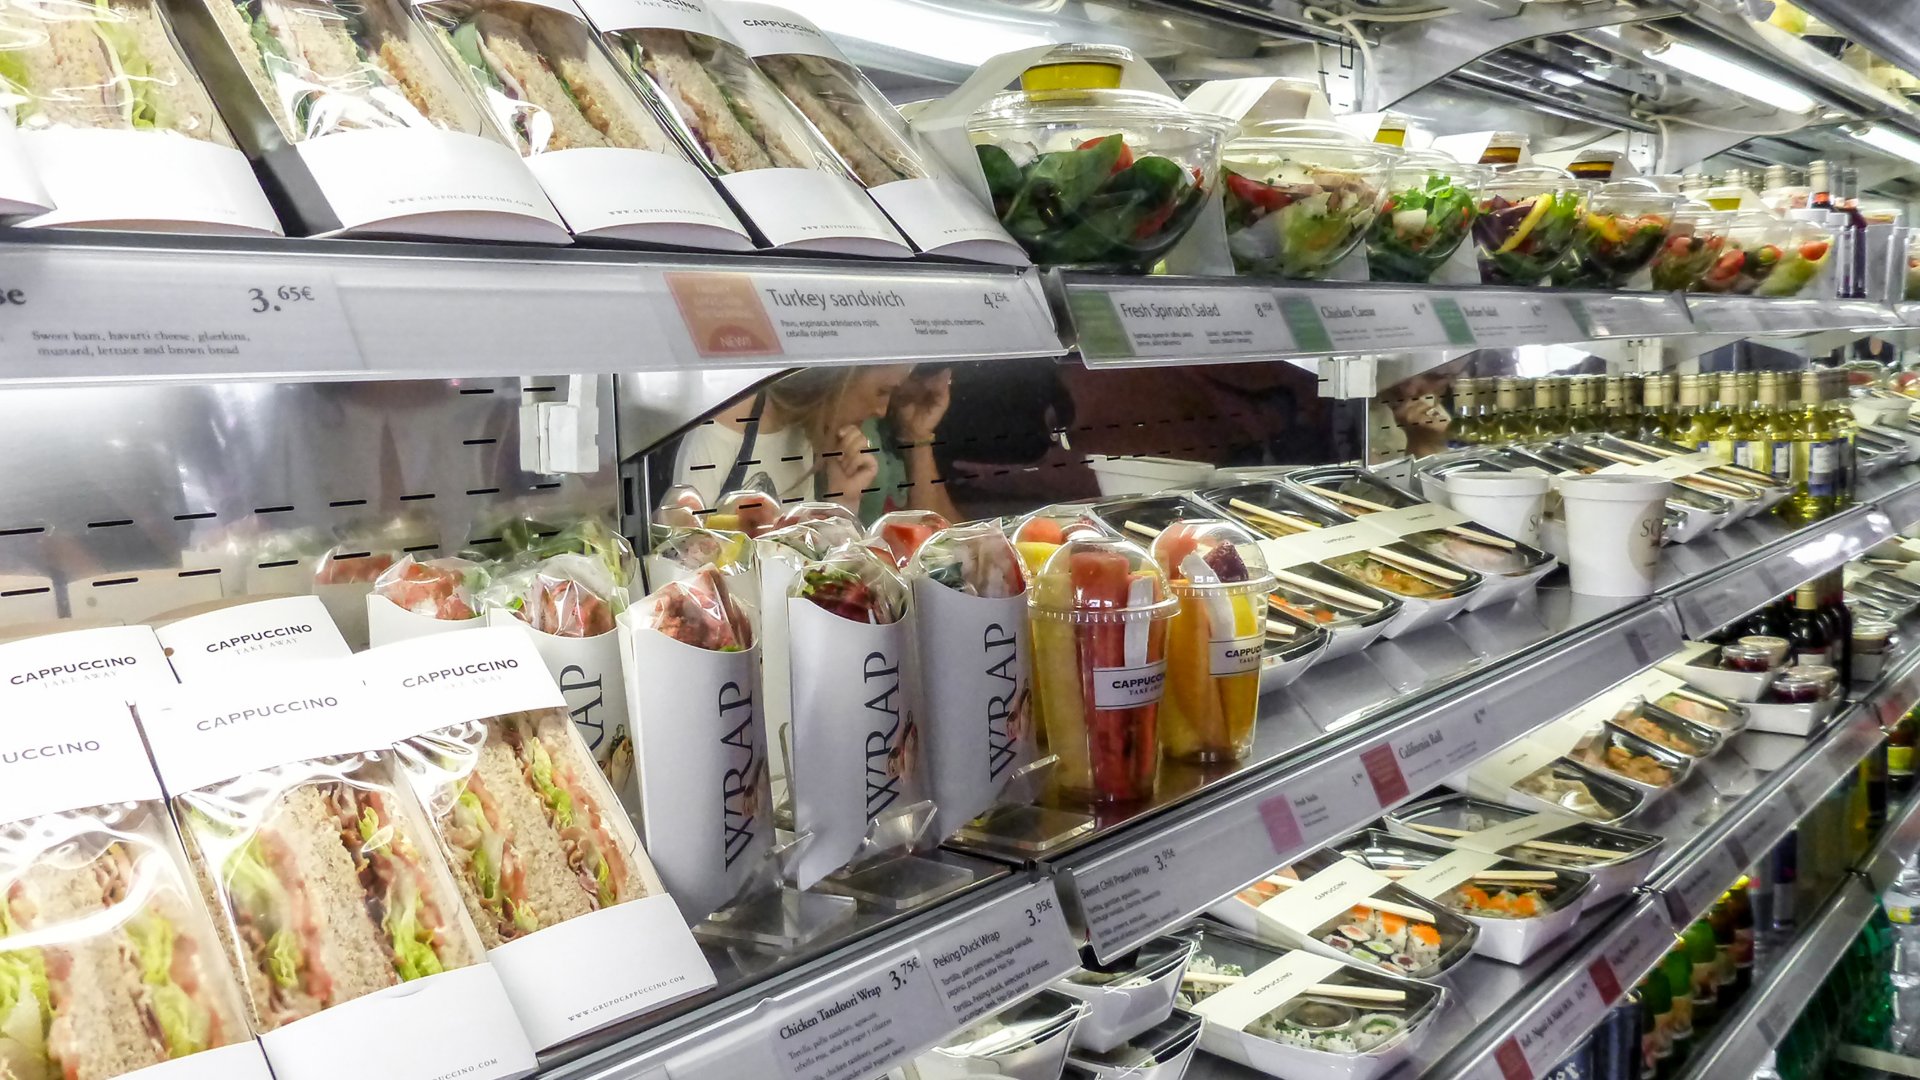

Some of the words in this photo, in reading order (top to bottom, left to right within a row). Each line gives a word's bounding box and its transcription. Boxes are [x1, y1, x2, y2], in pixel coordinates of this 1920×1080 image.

[743, 18, 822, 37] CAPPUCCINO
[248, 285, 316, 315] 3.65€
[766, 288, 827, 312] Turkey
[830, 289, 906, 309] sandwich
[1119, 303, 1152, 319] Fresh
[1152, 303, 1193, 321] Spinach
[1192, 302, 1222, 318] Salad
[143, 345, 166, 356] and
[168, 344, 205, 356] brown
[206, 623, 313, 654] CAPPUCCINO
[10, 656, 138, 686] CAPPUCCINO
[402, 658, 519, 689] CAPPUCCINO
[196, 696, 339, 732] CAPPUCCINO
[558, 664, 606, 755] AP
[984, 622, 1018, 784] WRAP
[1, 740, 101, 765] UCCINO
[864, 651, 902, 826] WRAP
[719, 681, 756, 872] WRAP
[932, 946, 962, 970] Peking
[959, 939, 980, 959] Duck
[978, 930, 1001, 950] Wrap
[1025, 898, 1054, 927] 3.95€
[567, 975, 687, 1022] WWW.GRUPOCAPPUCCINO.COM
[779, 1016, 819, 1041] Chicken
[817, 994, 859, 1022] Tandoori
[857, 985, 882, 1005] Wrap
[888, 957, 921, 991] 3.75€
[437, 1058, 499, 1080] UCCINO.COM
